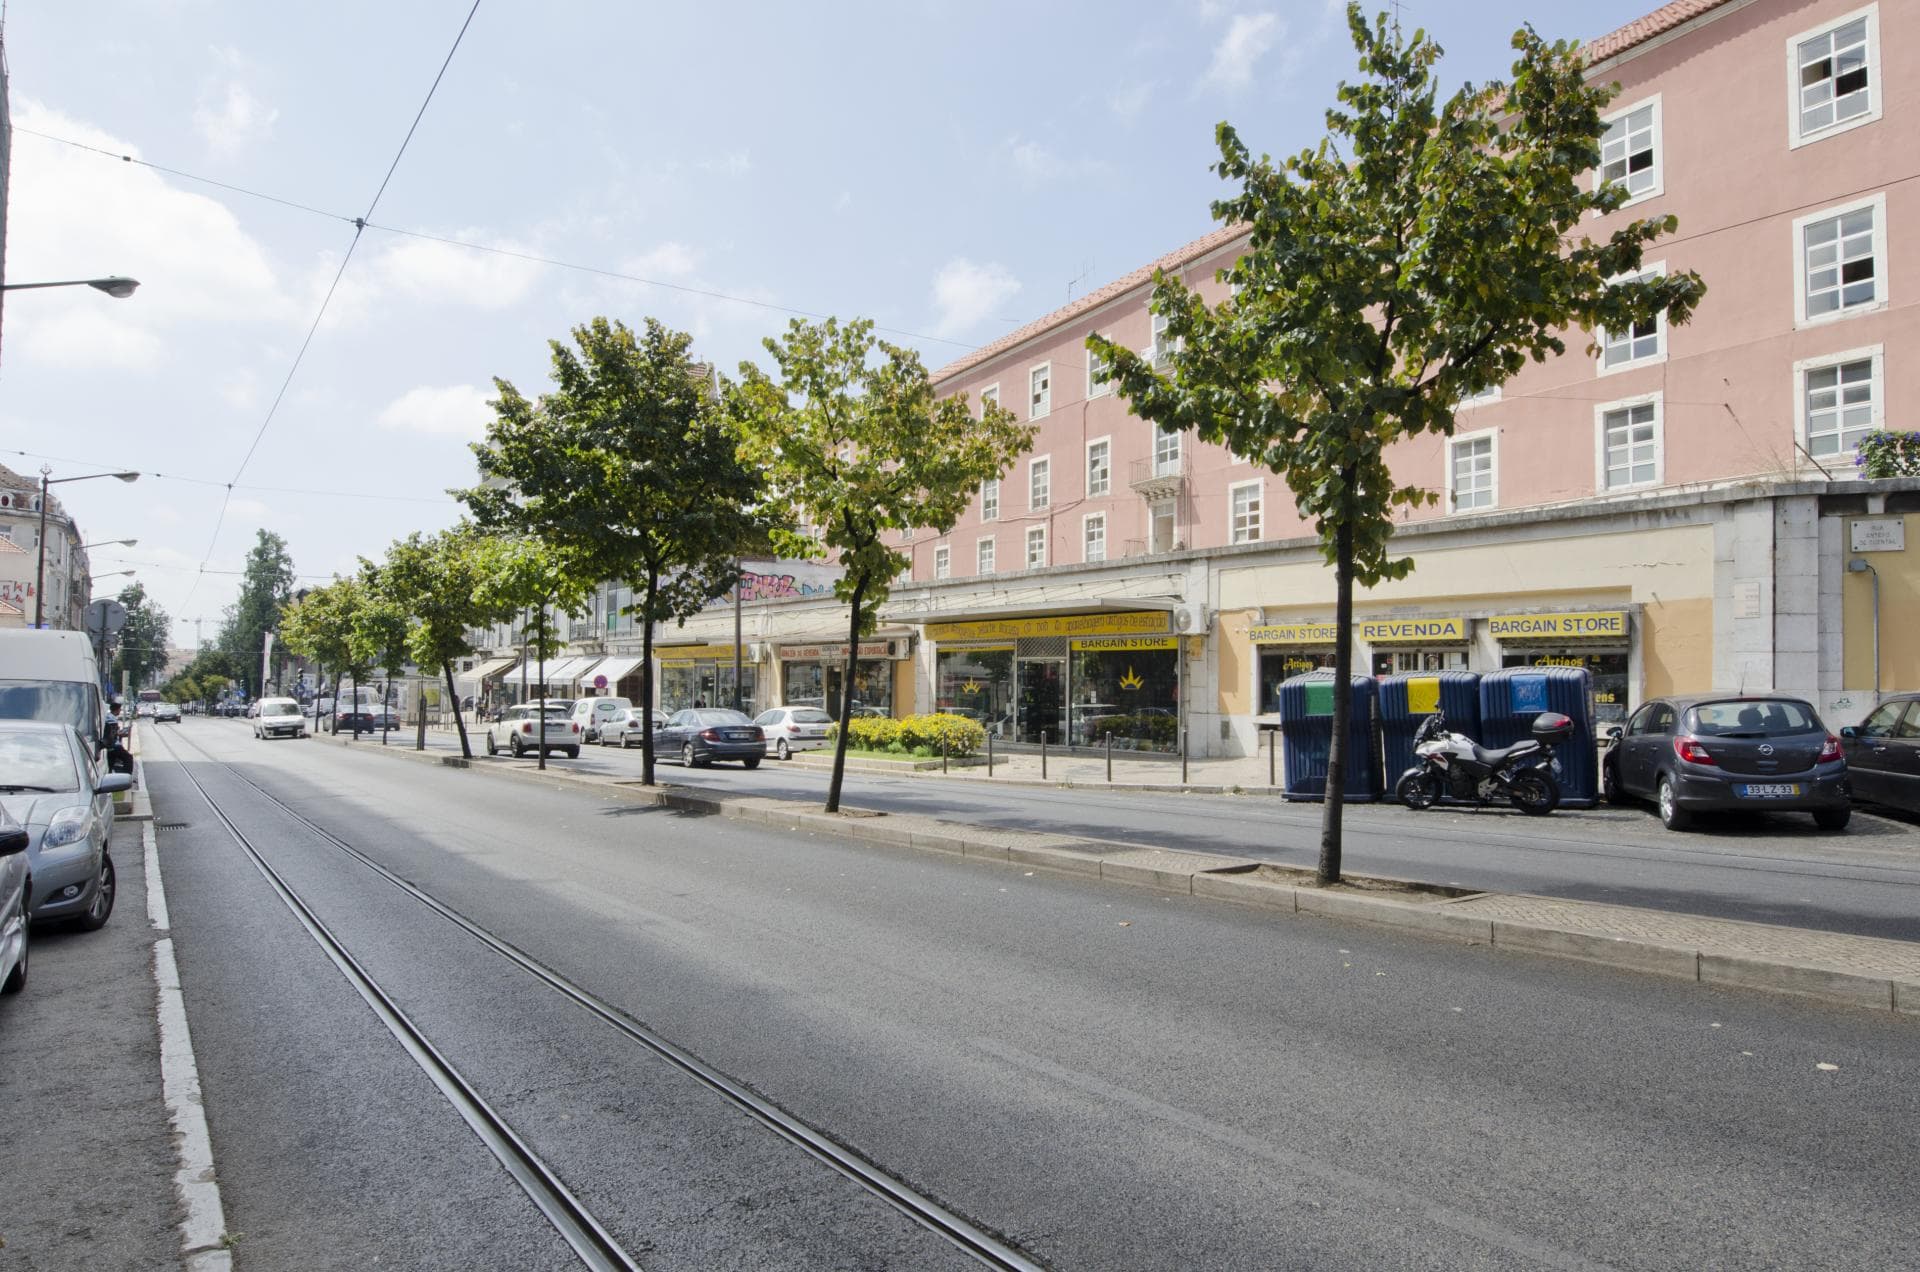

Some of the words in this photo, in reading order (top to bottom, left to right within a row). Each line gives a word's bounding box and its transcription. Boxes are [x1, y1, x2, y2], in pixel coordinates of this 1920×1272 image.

[1363, 622, 1457, 638] REVENDA
[1489, 618, 1557, 634] BARGAIN
[1562, 616, 1621, 632] STORE
[1249, 628, 1296, 642] BARGAIN
[1299, 627, 1337, 640] STORE
[1081, 639, 1127, 648] BARGAIN
[1130, 638, 1168, 647] STORE
